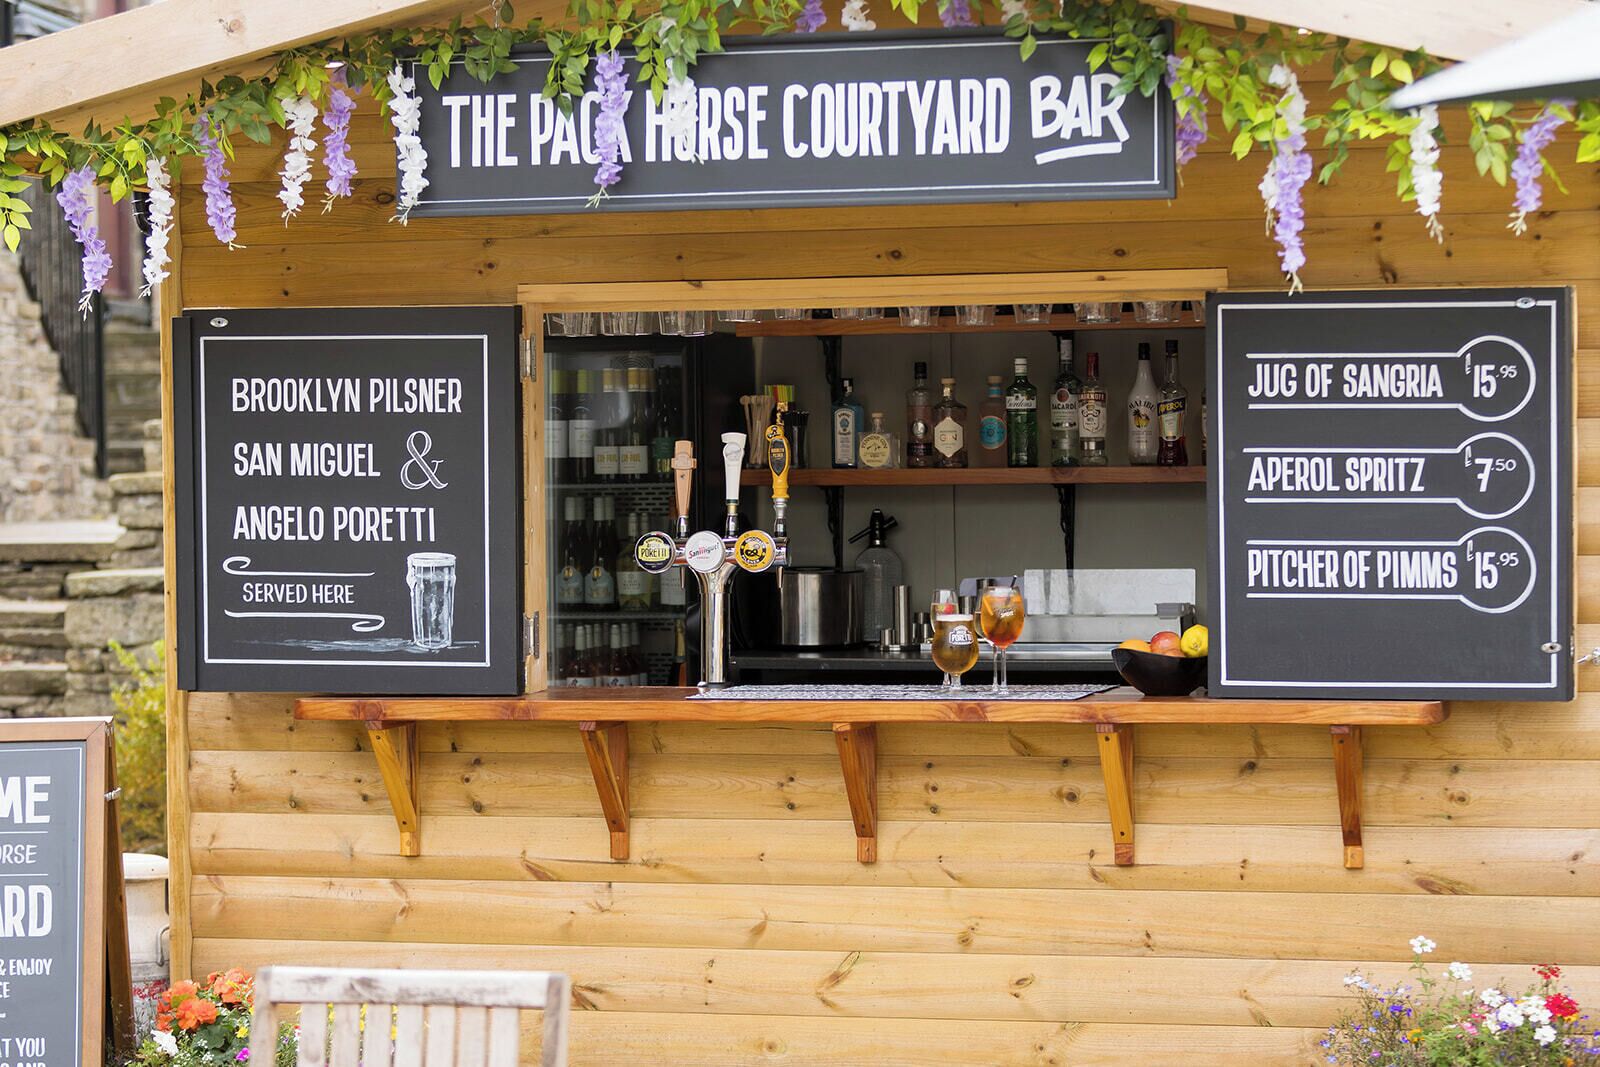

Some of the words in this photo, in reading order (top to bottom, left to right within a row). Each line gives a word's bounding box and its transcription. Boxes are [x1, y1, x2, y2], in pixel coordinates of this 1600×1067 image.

[442, 94, 518, 167] THE
[783, 78, 1010, 158] COURTYARD
[1030, 73, 1130, 142] BAR
[233, 378, 360, 412] BROOKLYN
[370, 378, 462, 413] PILSNER
[1248, 364, 1297, 397] JUG
[1306, 364, 1333, 397] OF
[1344, 364, 1443, 397] SANGRIA
[234, 443, 281, 476] SAN
[291, 443, 381, 477] MIGUEL
[401, 431, 448, 489] &
[1247, 456, 1340, 491] APEROL
[1345, 456, 1426, 492] SPRITZ
[233, 505, 325, 541] ANGELO
[334, 506, 436, 542] PORETTI
[1247, 549, 1339, 587] PITCHER
[1343, 550, 1371, 588] OF
[1377, 551, 1458, 588] PIMMS
[242, 582, 308, 603] SERVED
[311, 583, 355, 603] HERE
[0, 844, 38, 864] RSE
[9, 958, 53, 976] ENJOY
[15, 1037, 46, 1057] YOU
